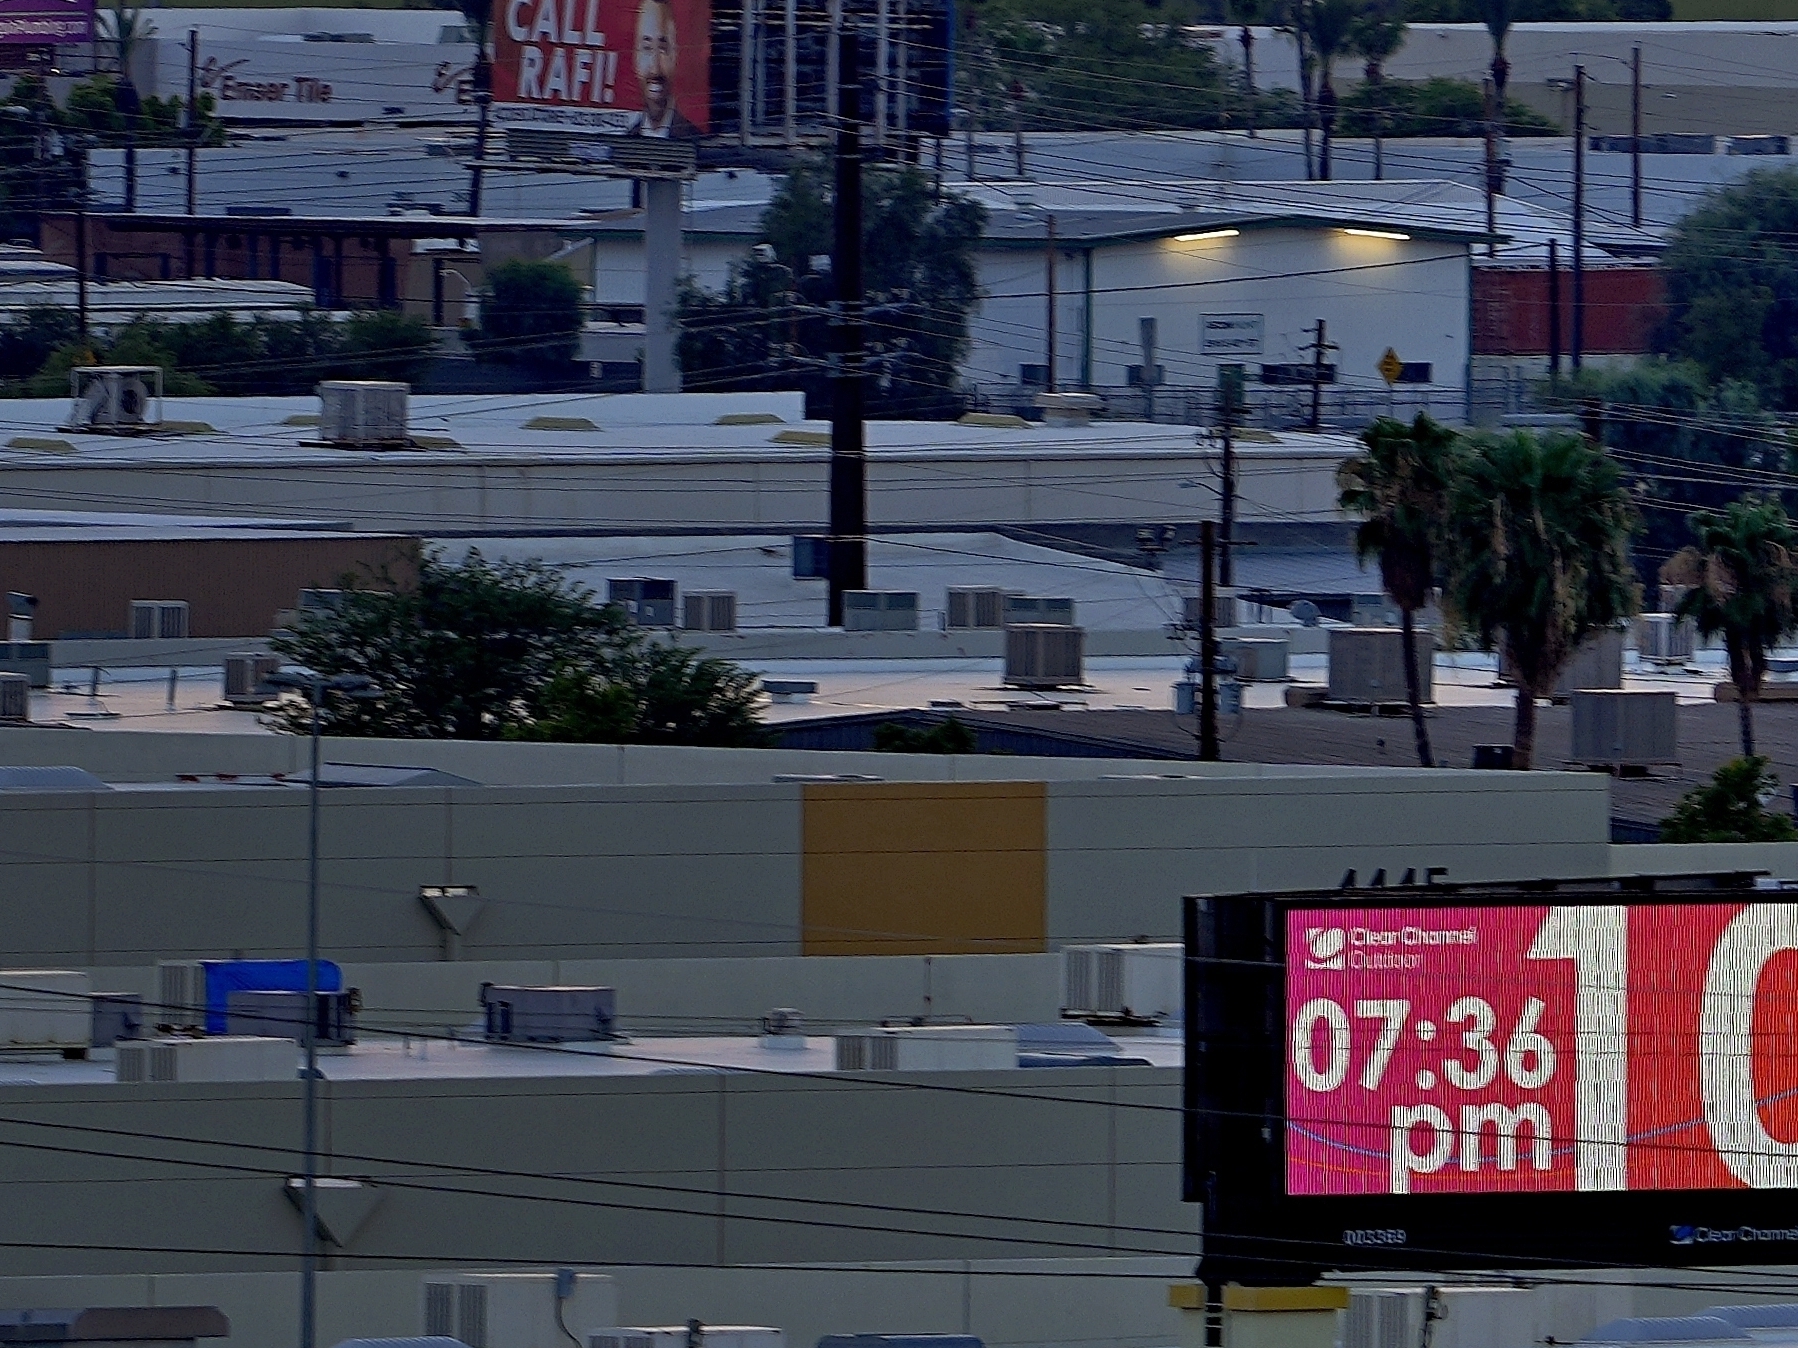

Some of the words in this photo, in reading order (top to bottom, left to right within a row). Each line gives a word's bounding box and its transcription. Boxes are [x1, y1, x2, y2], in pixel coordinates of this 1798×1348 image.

[517, 45, 618, 103] RAFI!
[1350, 927, 1399, 946] Clear
[1402, 926, 1478, 946] Channel
[1293, 995, 1557, 1093] 07:36
[1389, 1102, 1552, 1195] pm
[1694, 1226, 1737, 1242] Clear
